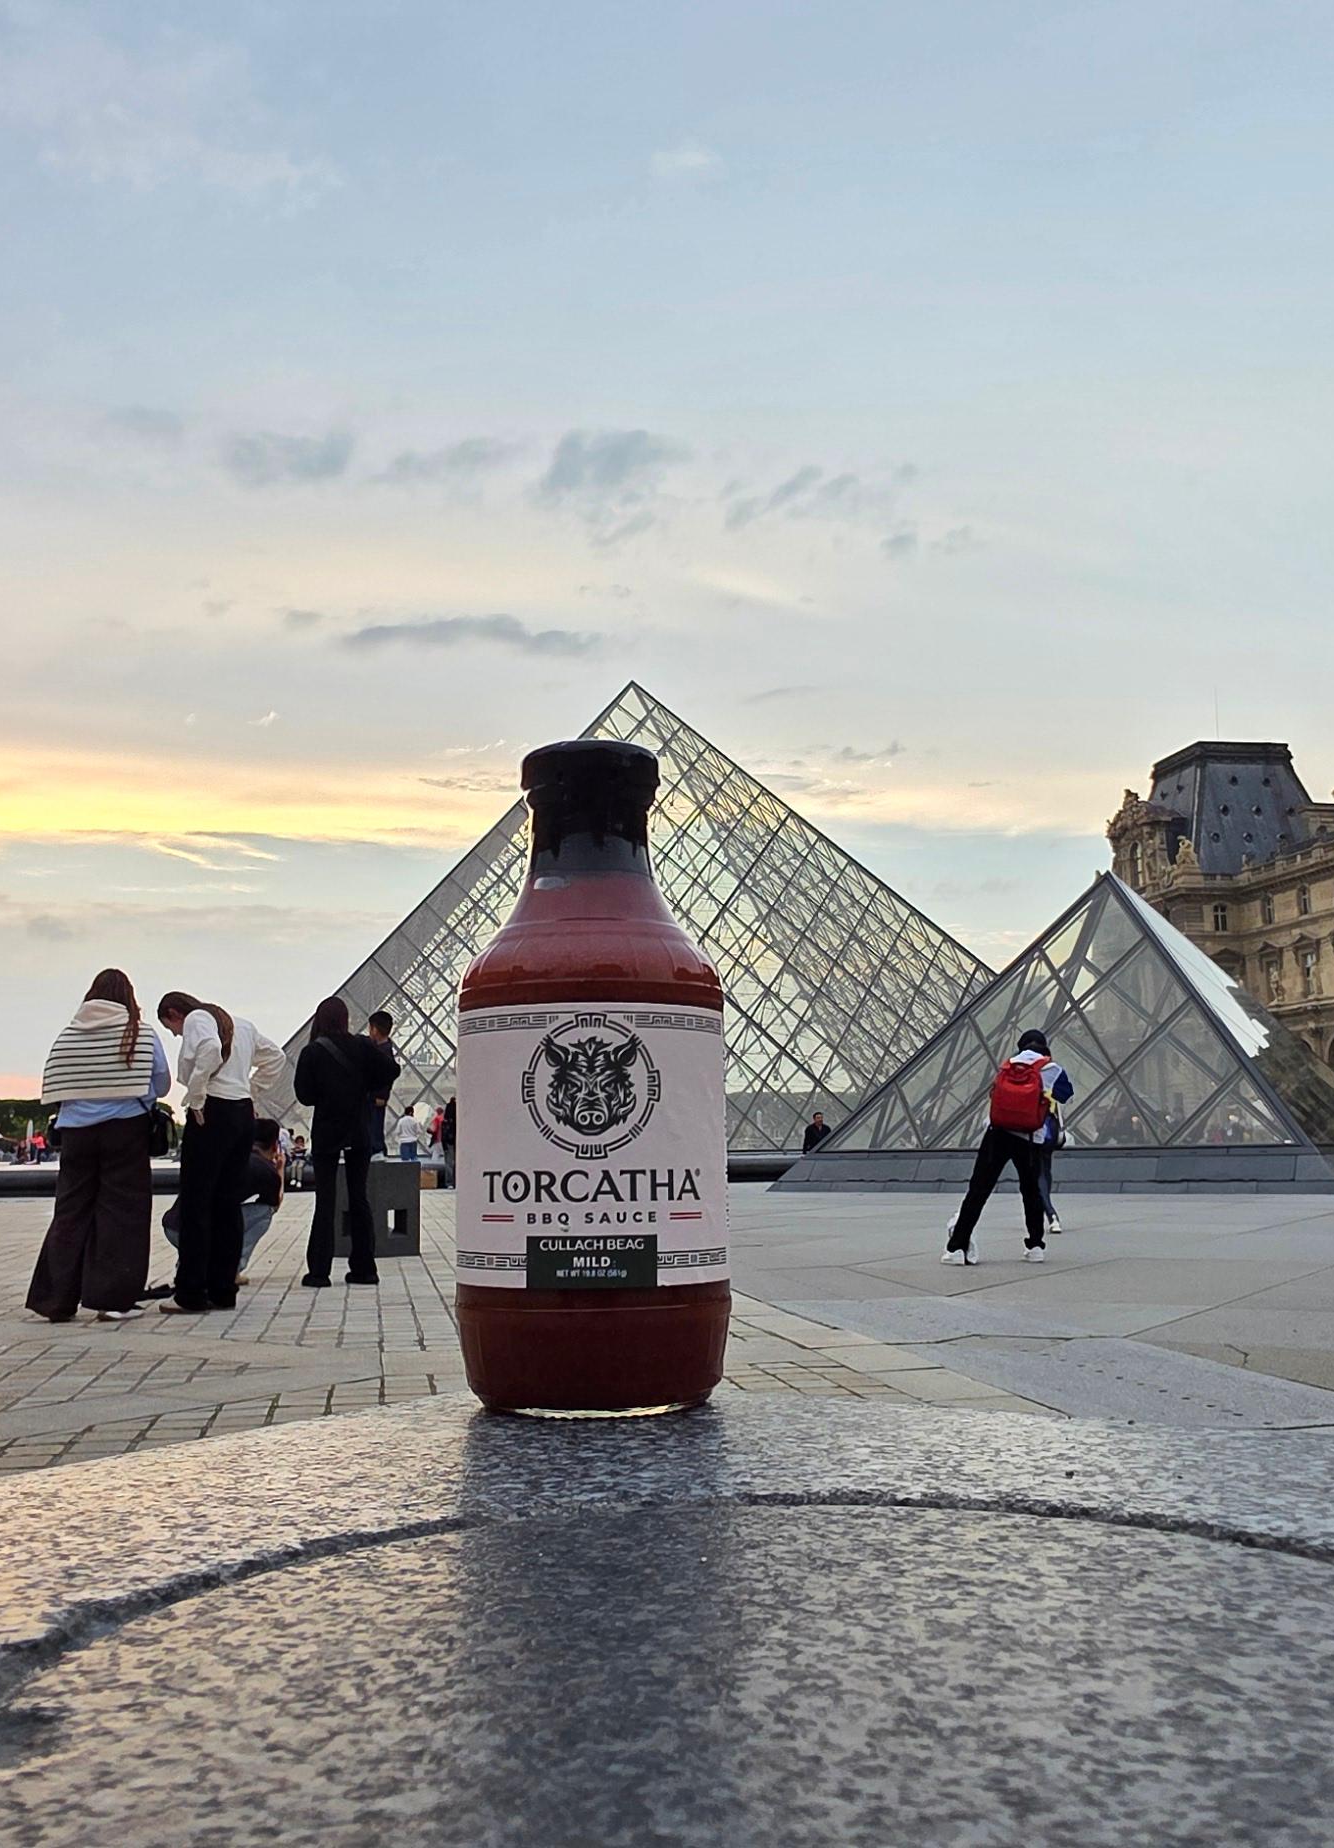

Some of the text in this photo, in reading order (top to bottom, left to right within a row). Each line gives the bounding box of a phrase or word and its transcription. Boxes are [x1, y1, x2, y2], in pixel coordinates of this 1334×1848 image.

[482, 1168, 700, 1203] TORCATHA
[526, 1211, 657, 1225] BBQ SAUCE
[539, 1238, 645, 1251] CULLACH BEAG
[573, 1256, 611, 1268] MILD
